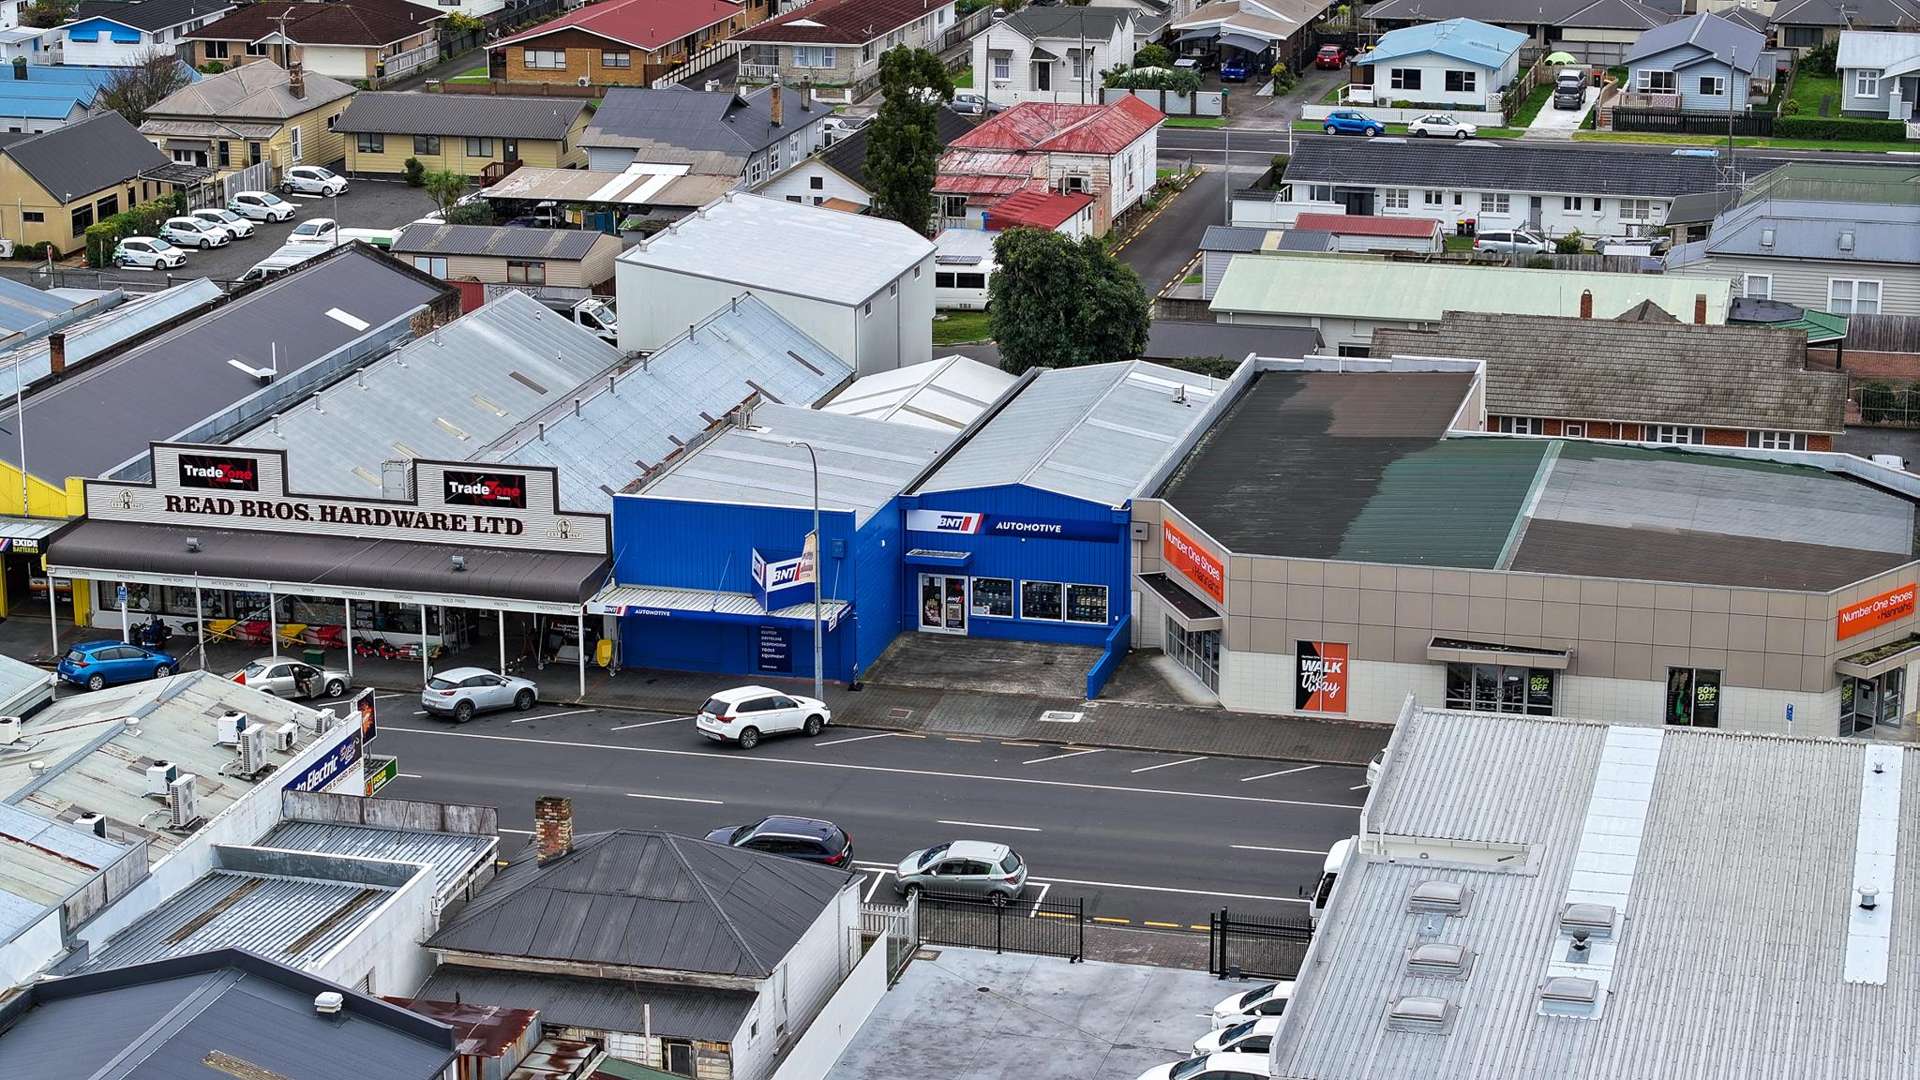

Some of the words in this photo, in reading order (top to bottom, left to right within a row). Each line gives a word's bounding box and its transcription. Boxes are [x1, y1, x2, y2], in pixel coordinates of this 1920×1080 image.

[183, 463, 253, 482] TradeZone
[448, 480, 521, 499] TradeZone
[164, 494, 235, 516] READ
[239, 499, 314, 521] BROS.
[319, 504, 467, 532] HARDWARE
[472, 514, 524, 536] LTD
[937, 516, 963, 529] BNT
[995, 522, 1062, 533] AUTOMOTIVE
[12, 538, 39, 547] EXIDE
[1165, 527, 1189, 556] Number
[1187, 546, 1201, 566] One
[1200, 556, 1220, 581] Shoes
[772, 564, 798, 584] BNT
[634, 608, 672, 617] AUTOMOTIVE
[1842, 604, 1873, 623] Number
[1872, 600, 1889, 612] One
[1888, 591, 1913, 606] Shoes
[1301, 659, 1343, 674] WALK
[1300, 670, 1328, 688] This
[1530, 677, 1550, 685] 50%
[1697, 686, 1718, 694] 50%
[1697, 693, 1716, 701] OFF
[306, 754, 339, 792] Electric
